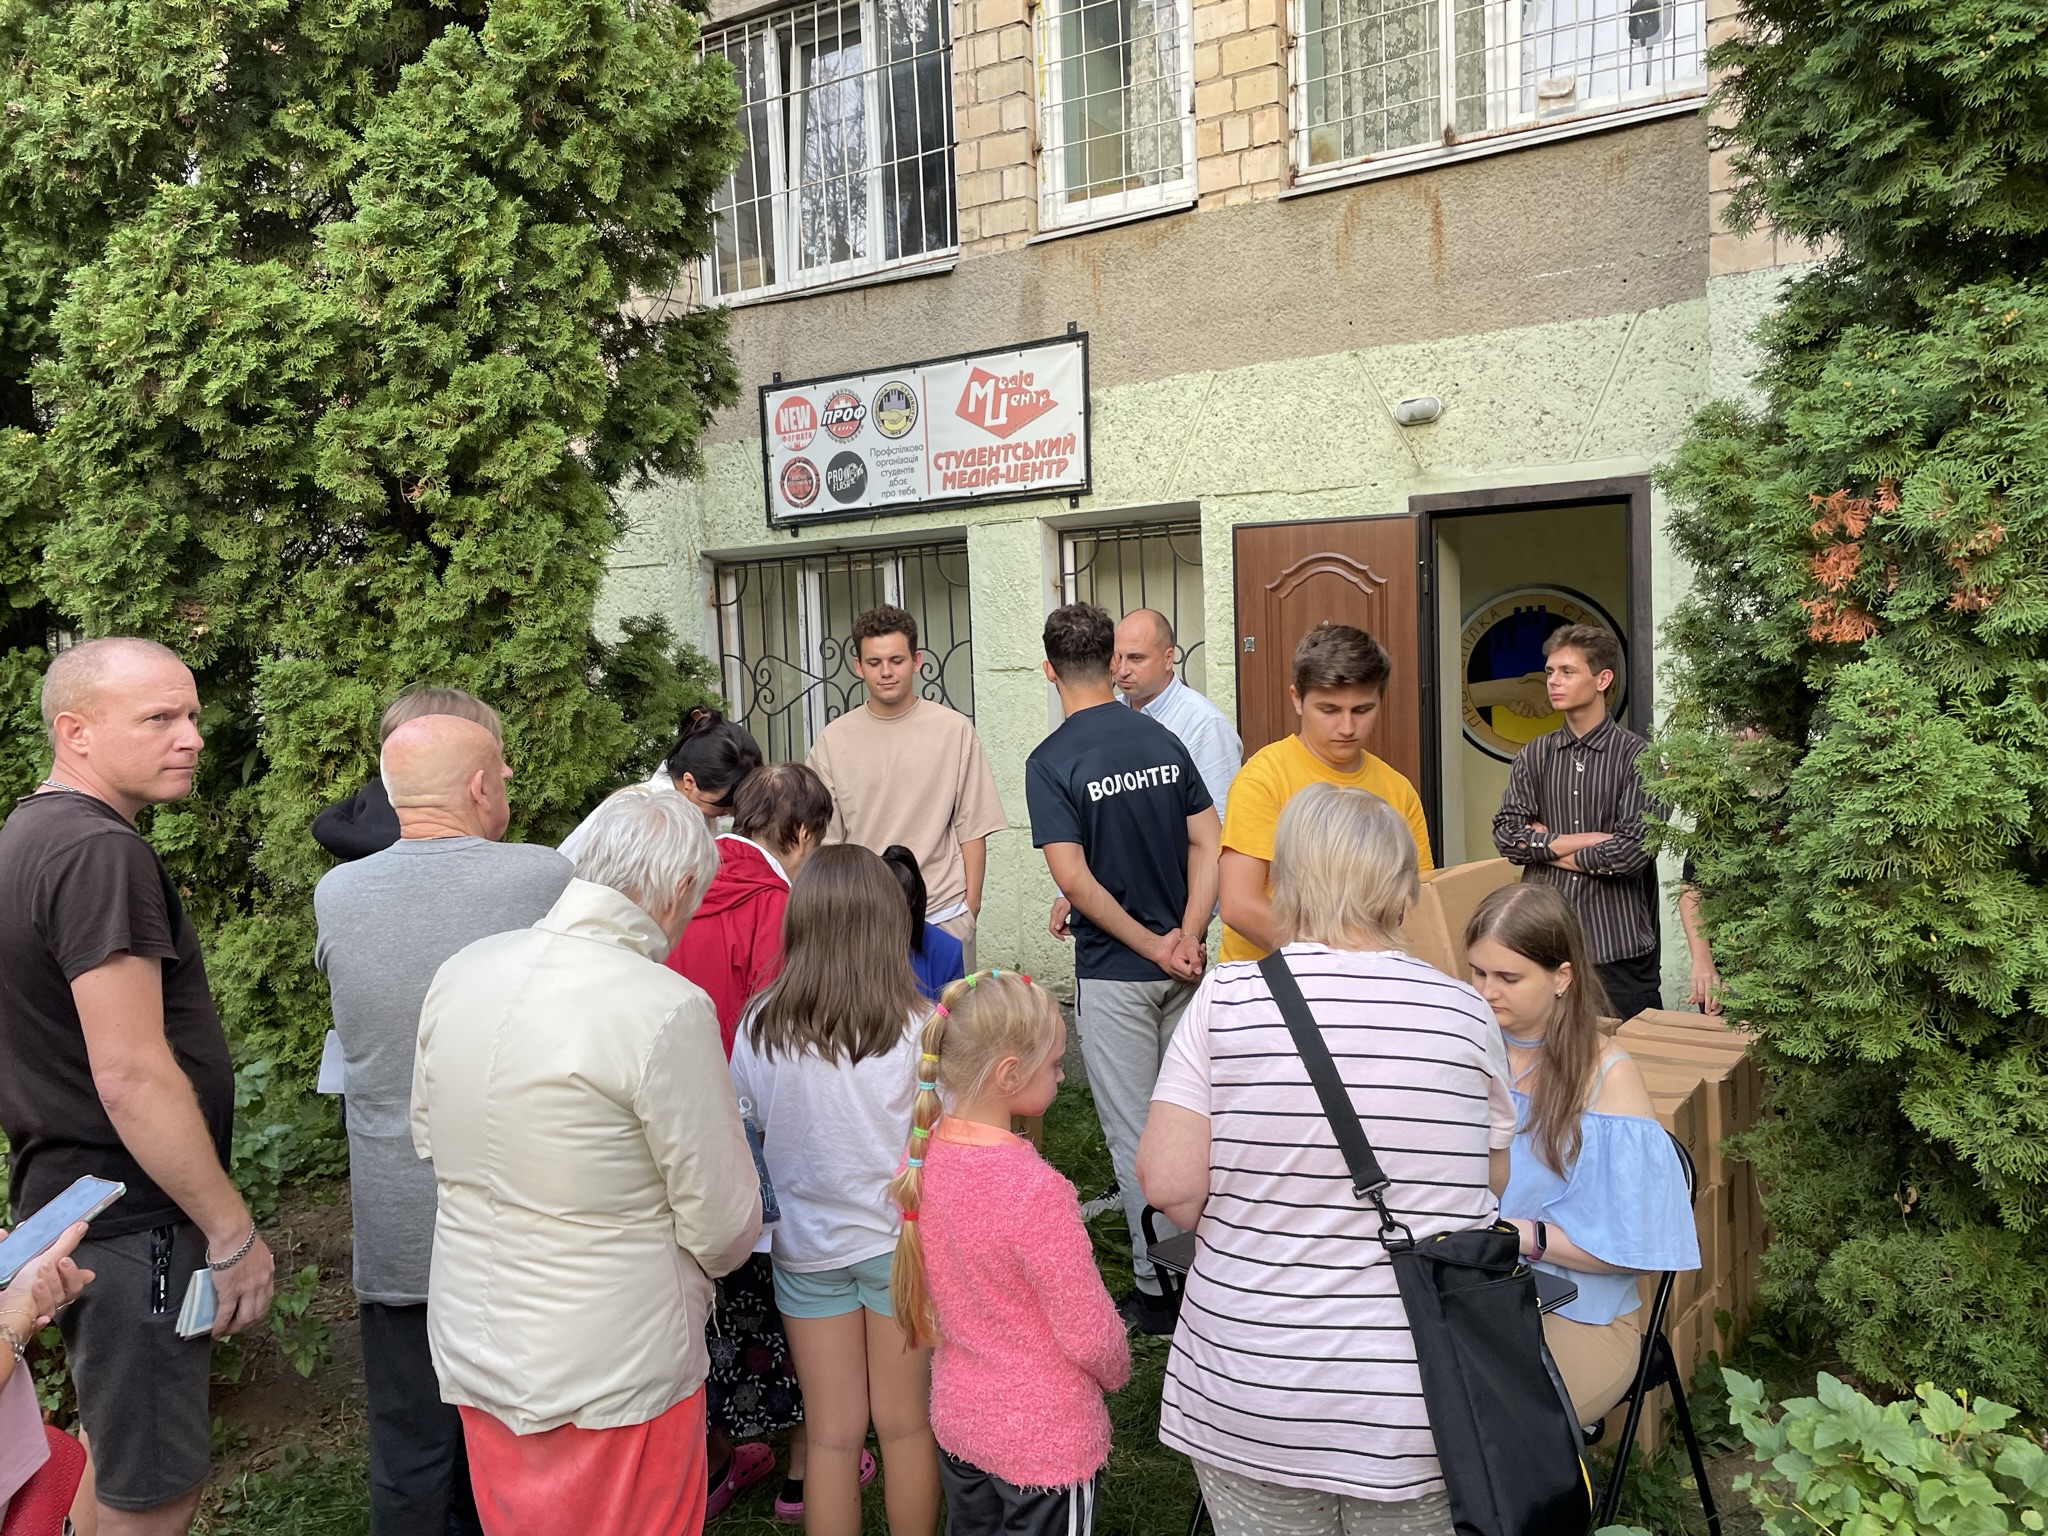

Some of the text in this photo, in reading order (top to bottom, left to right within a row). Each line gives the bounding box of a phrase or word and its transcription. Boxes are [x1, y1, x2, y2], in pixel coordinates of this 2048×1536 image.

[779, 404, 811, 432] NEW
[822, 405, 866, 425] ПРОФ
[869, 444, 924, 458] Профспілкова
[933, 432, 1077, 471] СТУДЕНТСЬКИЙ
[875, 454, 919, 469] організація
[827, 467, 843, 485] PRO
[880, 465, 915, 478] студентів
[941, 457, 1069, 491] МЕДІА-ЦЕНТР
[888, 476, 908, 488] дбає
[881, 485, 917, 499] про тебе
[1086, 764, 1180, 802] ВОЛОНТЕР
